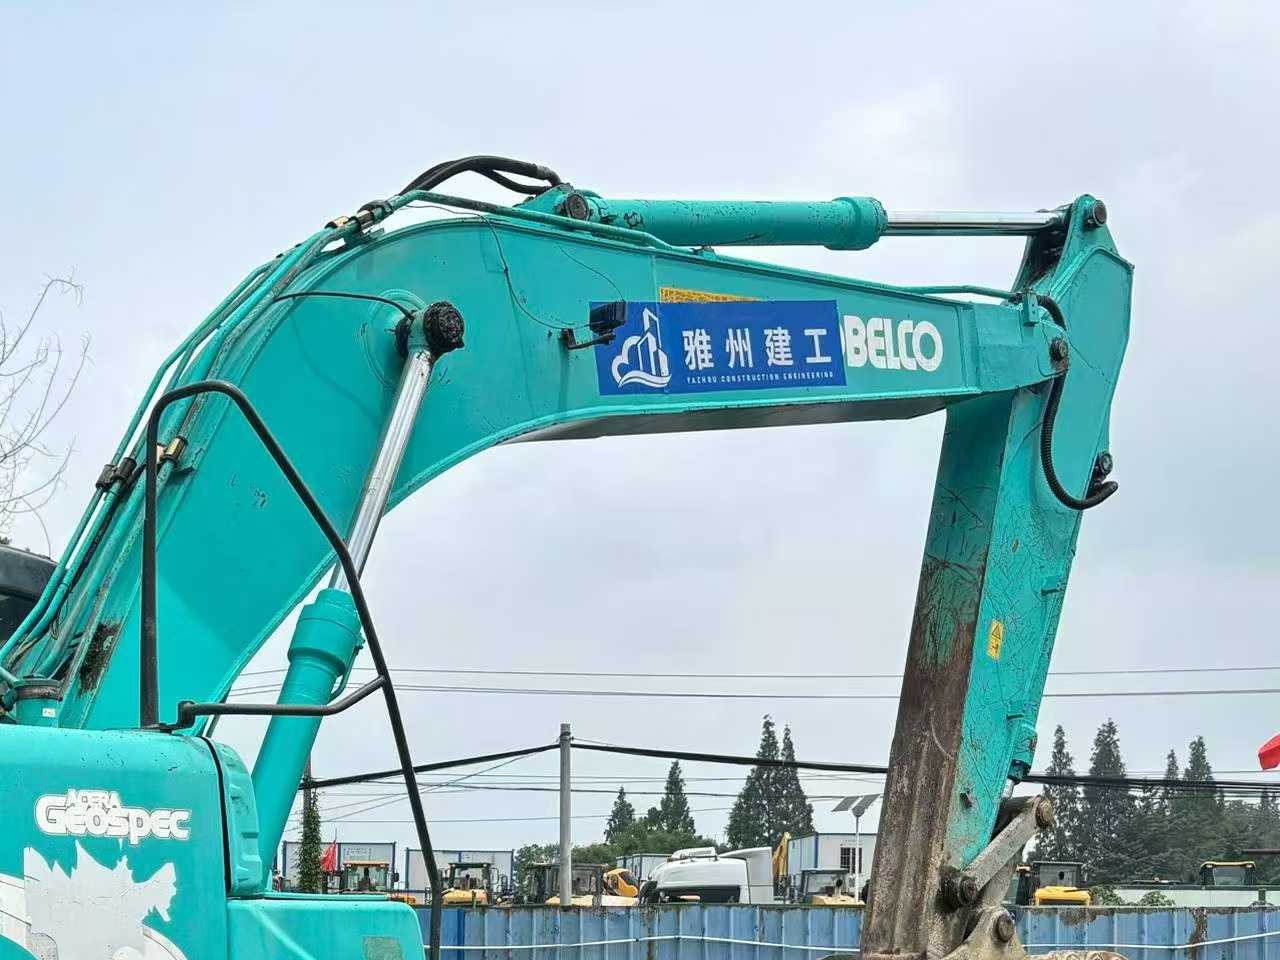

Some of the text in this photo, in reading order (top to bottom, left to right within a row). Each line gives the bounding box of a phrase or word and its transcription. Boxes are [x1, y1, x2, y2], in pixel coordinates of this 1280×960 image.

[682, 327, 832, 371] 雅州建工
[841, 315, 943, 372] BELCO
[686, 371, 834, 385] YAZHOU CONSTRUCTION ENGINEERING
